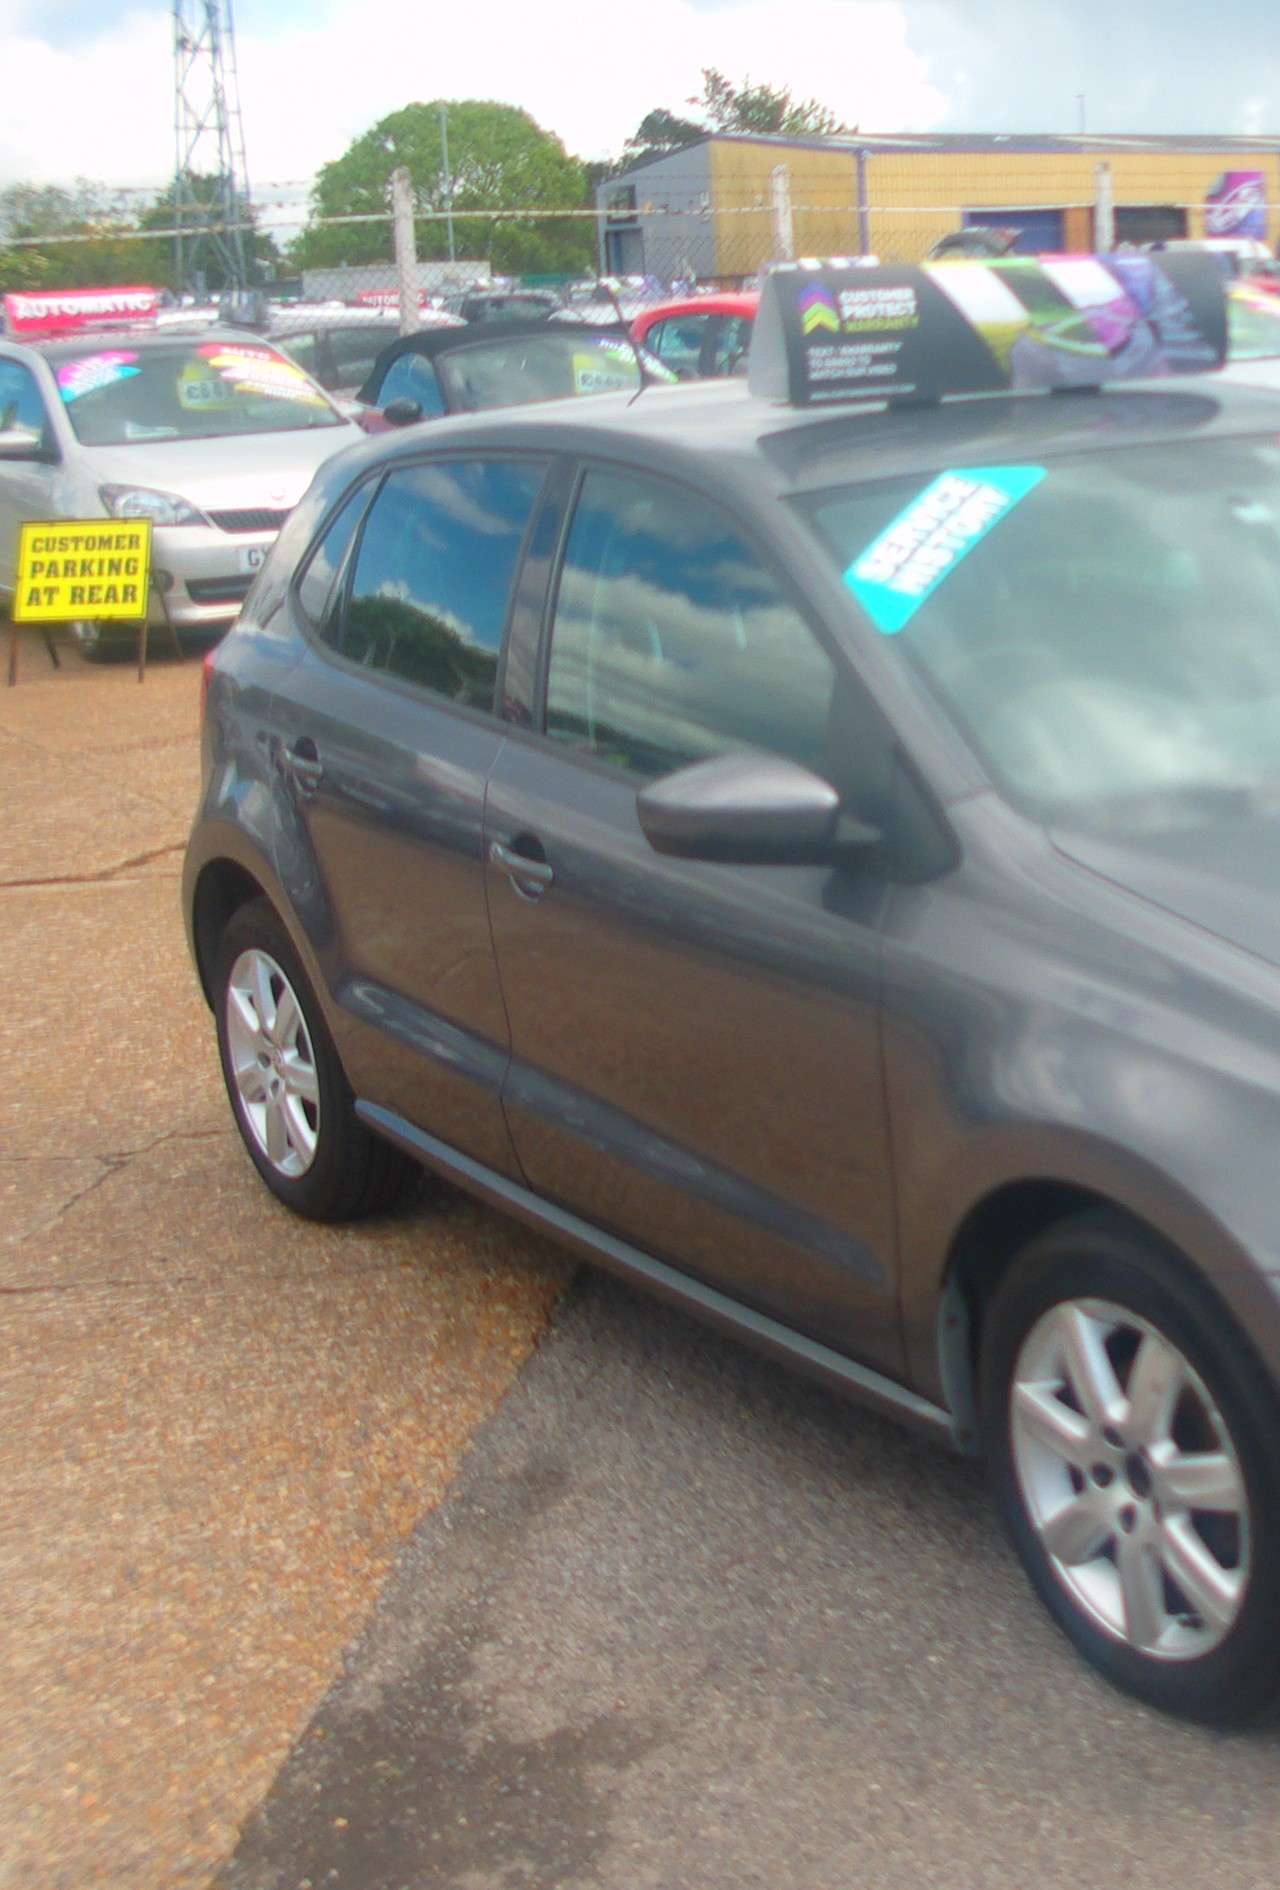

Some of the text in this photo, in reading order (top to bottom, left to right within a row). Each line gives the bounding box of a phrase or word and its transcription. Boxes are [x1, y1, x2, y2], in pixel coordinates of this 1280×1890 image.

[17, 293, 152, 319] AUTOMATIC
[31, 534, 140, 553] CUSTOMER
[31, 558, 138, 579] PARKING
[27, 584, 138, 607] AT REAR
